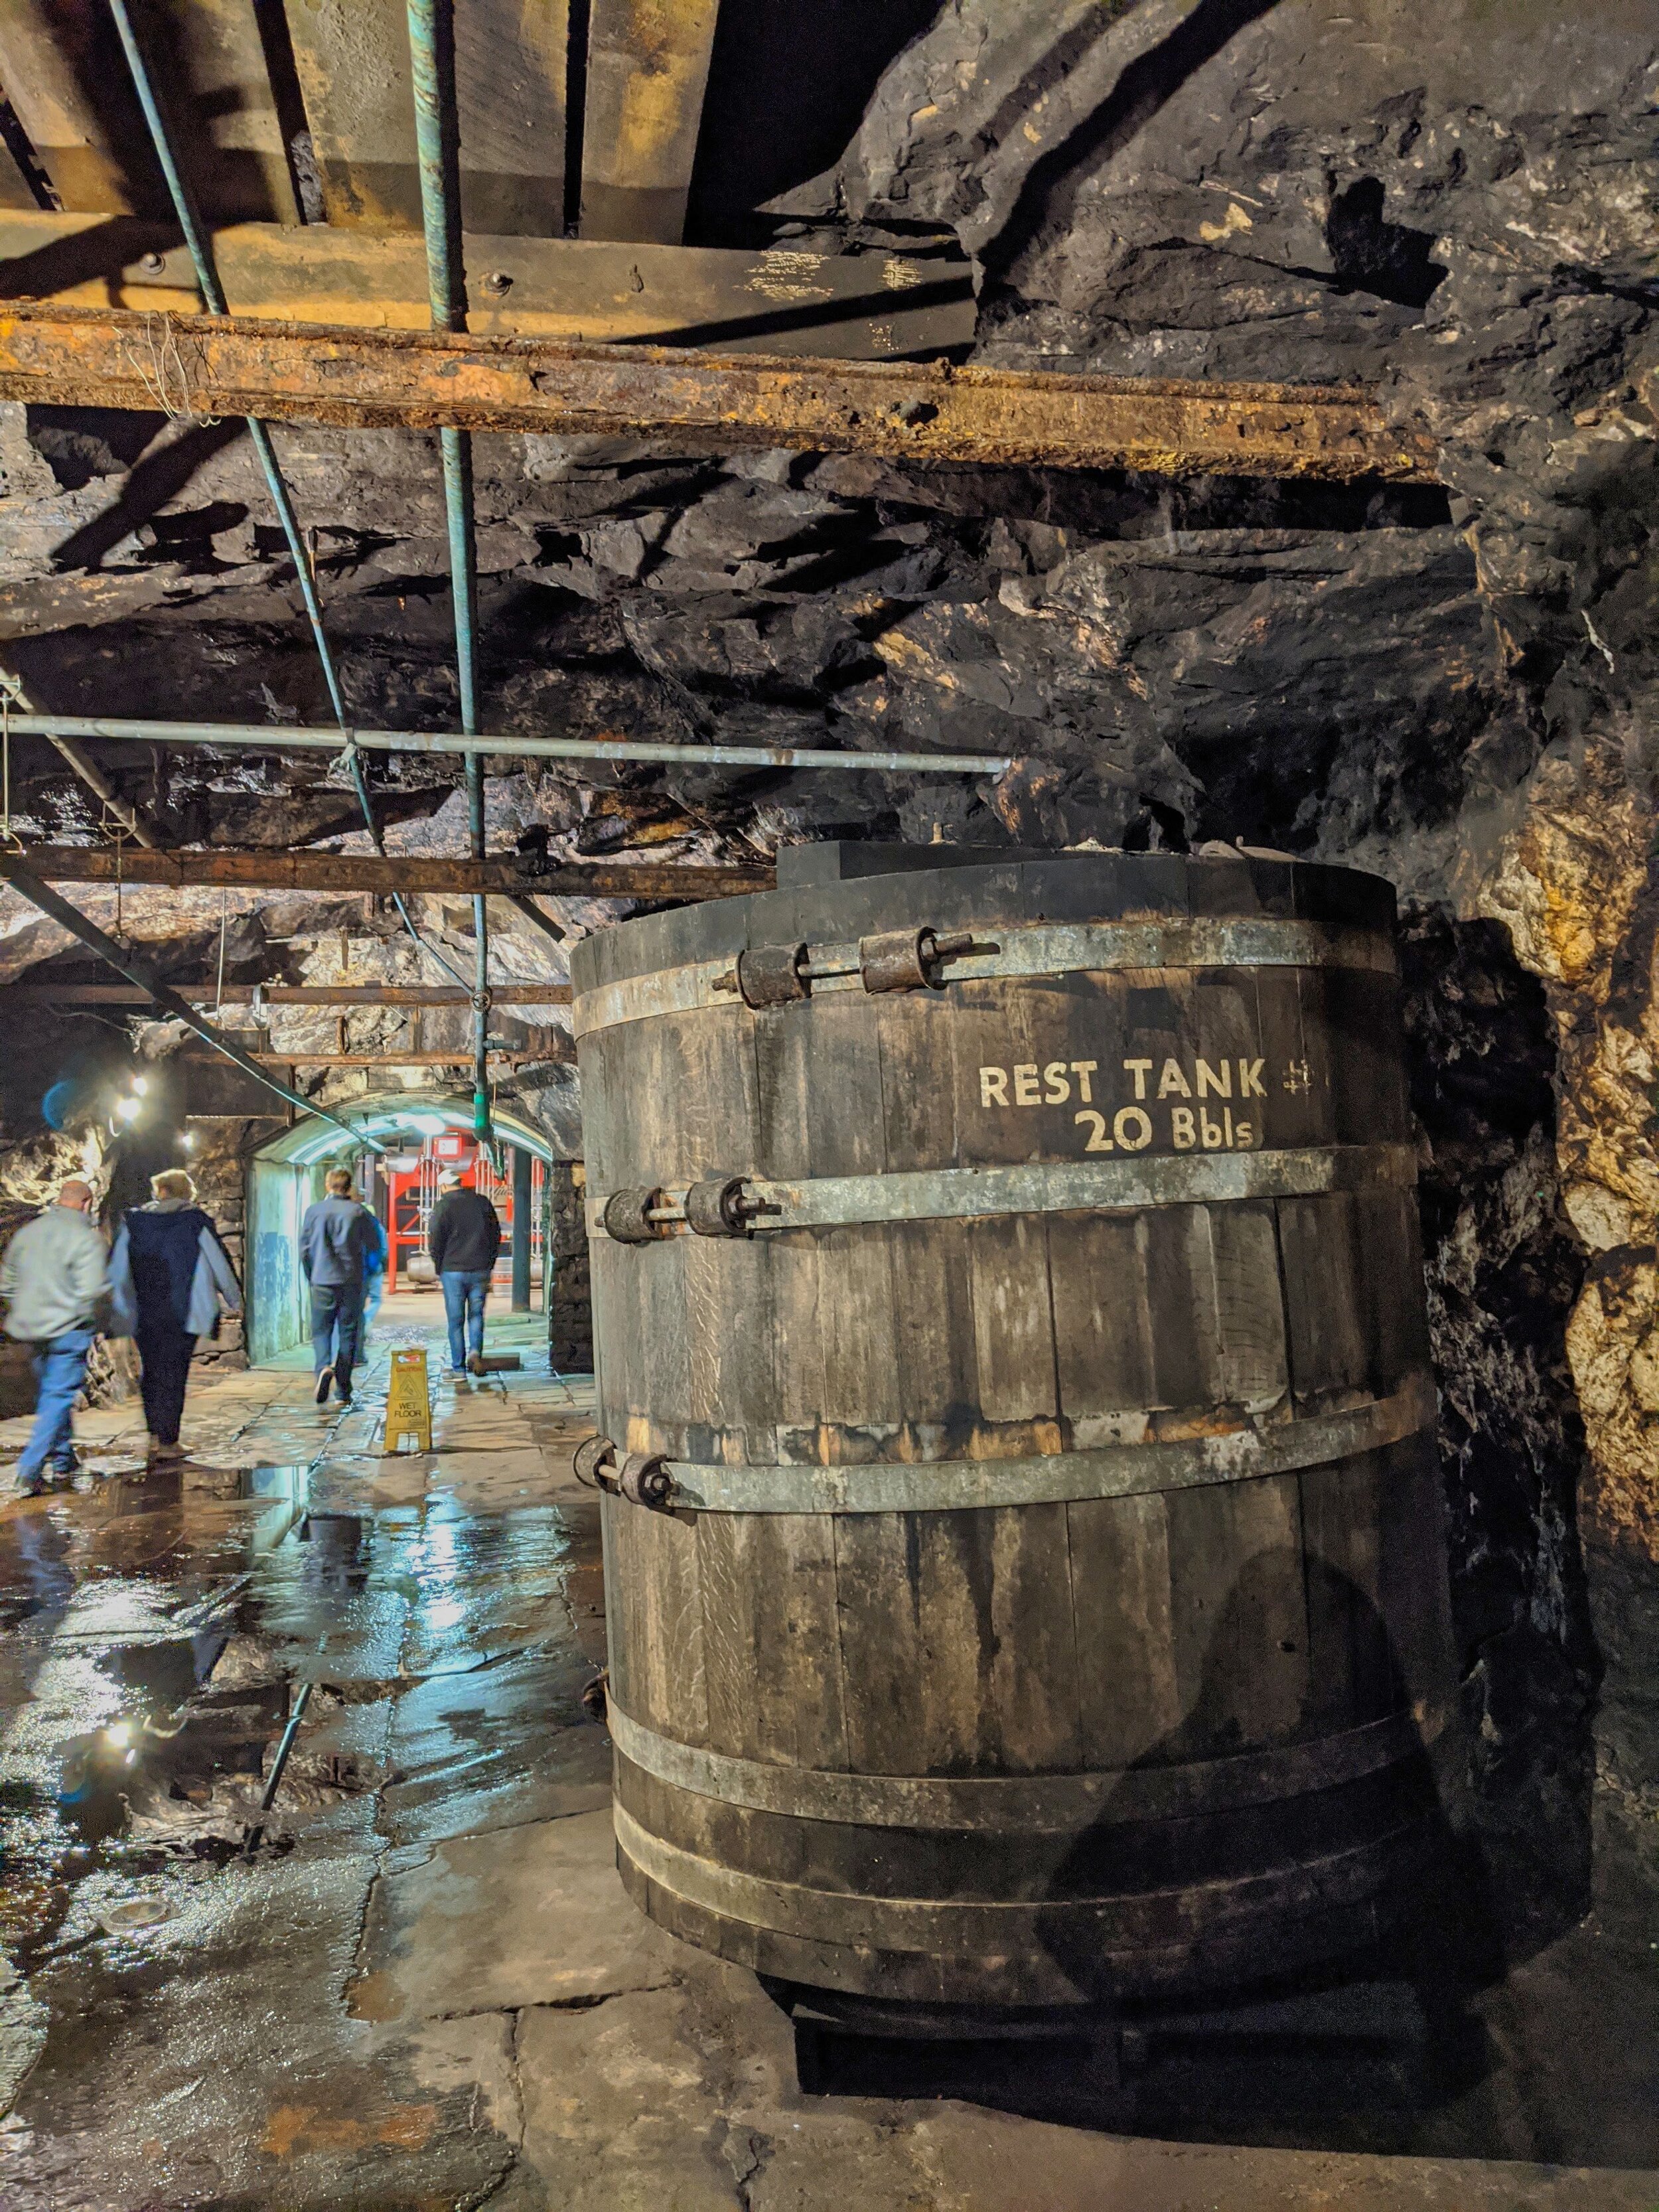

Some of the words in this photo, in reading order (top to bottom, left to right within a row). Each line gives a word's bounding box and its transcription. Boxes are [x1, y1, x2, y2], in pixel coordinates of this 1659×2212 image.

[979, 1060, 1098, 1108] REST
[1123, 1058, 1267, 1100] TANK
[1074, 1106, 1153, 1152] 20
[1171, 1106, 1253, 1150] Bbls
[399, 1401, 417, 1410] WET
